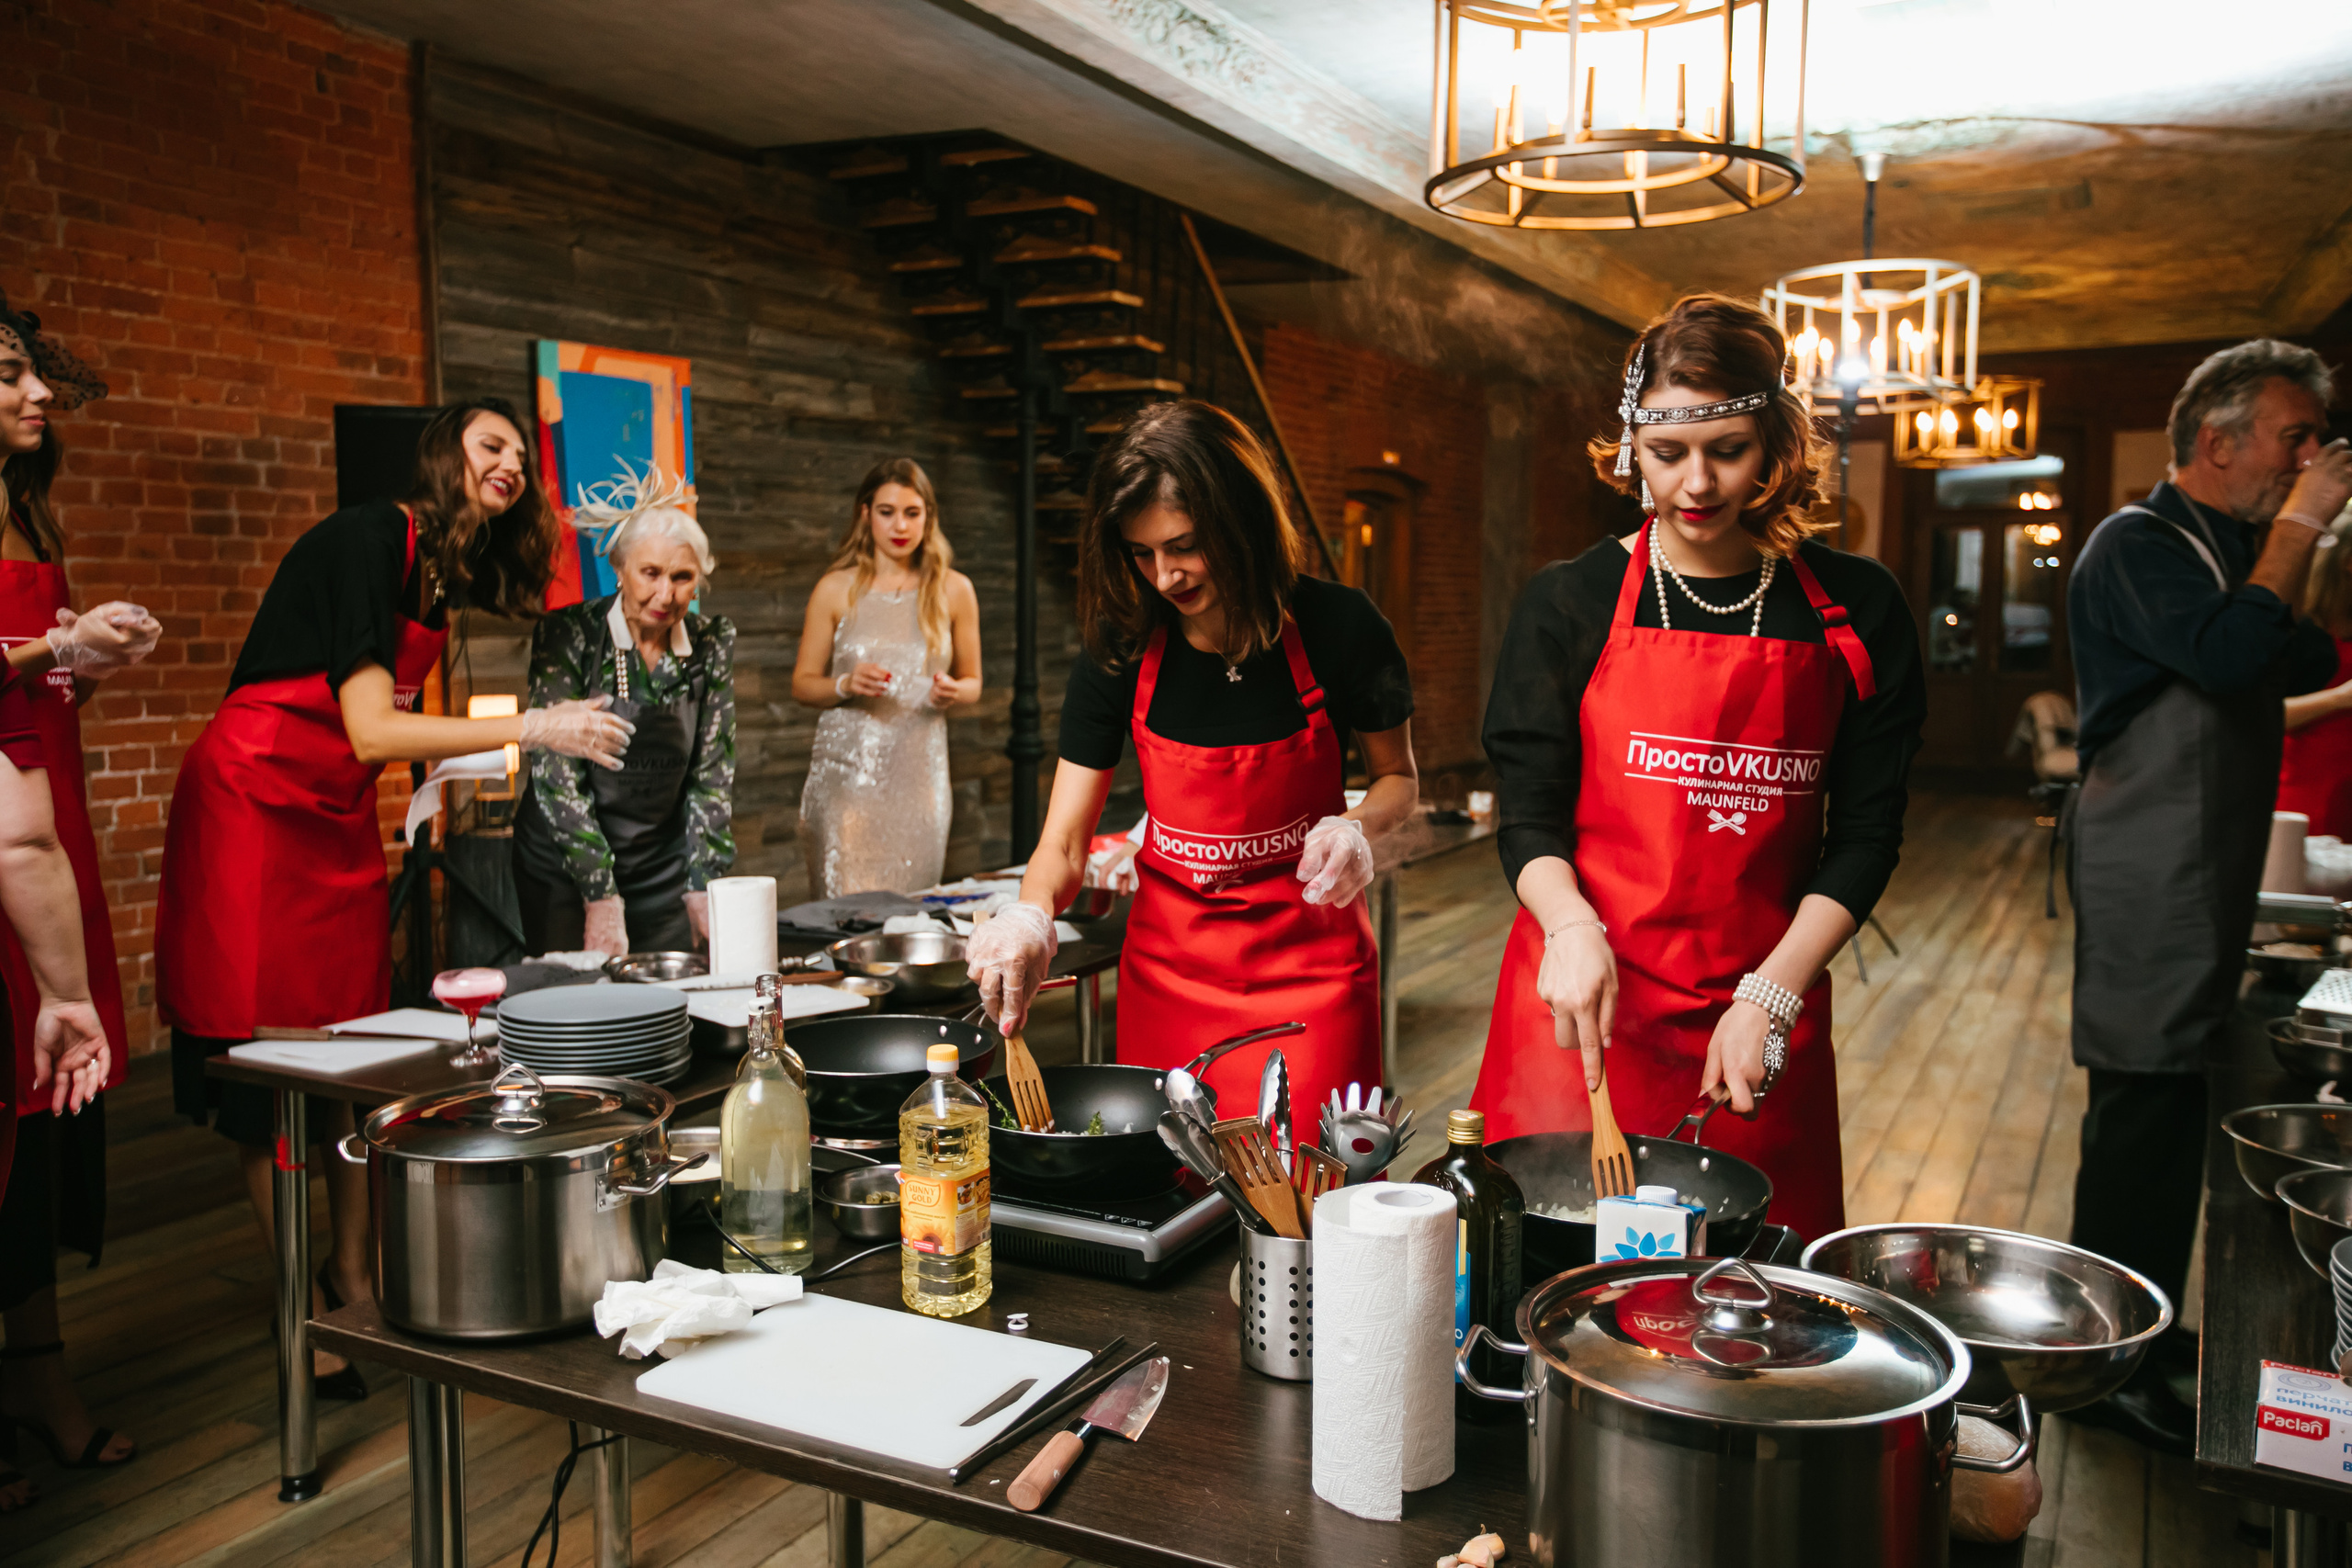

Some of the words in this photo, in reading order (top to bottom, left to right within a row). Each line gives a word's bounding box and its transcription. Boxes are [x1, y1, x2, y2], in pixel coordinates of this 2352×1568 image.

[1626, 739, 1821, 783] ПростоVKUSNO
[1678, 775, 1743, 792] КУЛИНАРНАЯ
[1745, 784, 1783, 796] СТУДИЯ
[1687, 790, 1770, 812] MAUNFELD
[1152, 820, 1310, 861] ПростоVKUSNO
[1184, 860, 1239, 872] КУЛИНАРНАЯ
[908, 1184, 935, 1196] SUNNY
[911, 1193, 933, 1203] GOLD
[2263, 1411, 2324, 1436] Paclan
